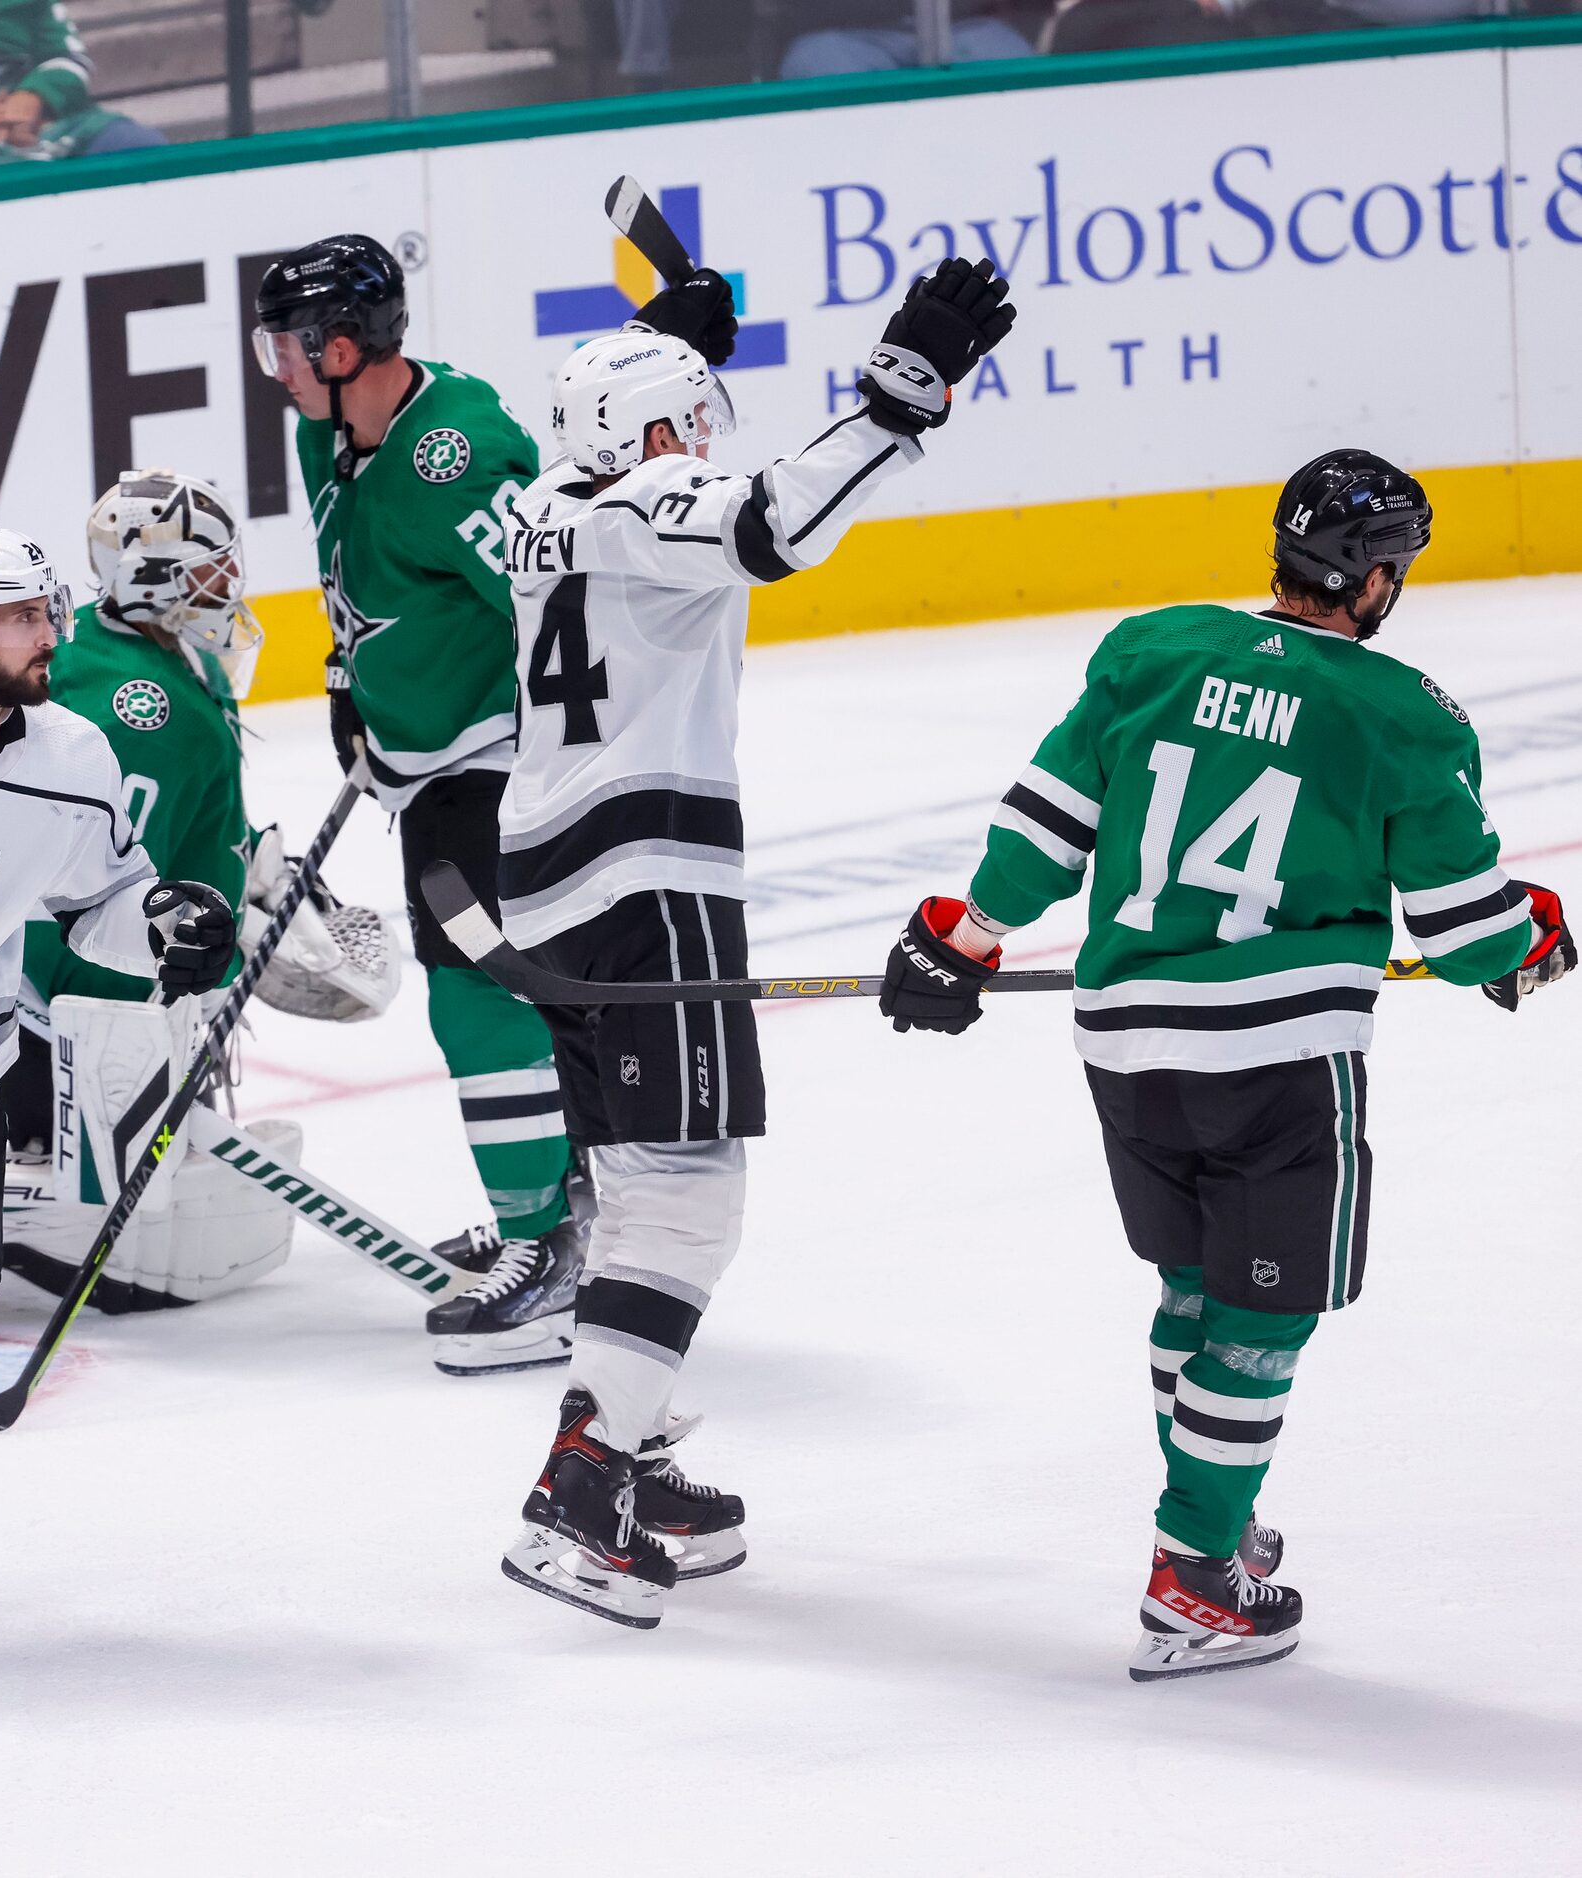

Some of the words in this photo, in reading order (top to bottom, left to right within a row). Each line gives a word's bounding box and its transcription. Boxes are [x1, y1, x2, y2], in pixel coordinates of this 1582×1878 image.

[609, 347, 660, 372] Spectrum
[827, 330, 1221, 414] HALTH
[1290, 503, 1314, 532] 14
[1385, 494, 1407, 503] ENERGY
[1386, 500, 1413, 510] TRANSFER
[512, 573, 611, 753] 4
[1252, 645, 1286, 657] adidas
[1192, 675, 1302, 748] BENN
[1113, 740, 1303, 944] 14
[696, 1044, 710, 1109] CCM
[59, 1034, 74, 1171] TRUE
[1257, 1266, 1276, 1281] NHL
[1253, 1544, 1272, 1559] CCM
[1161, 1586, 1251, 1635] CCM
